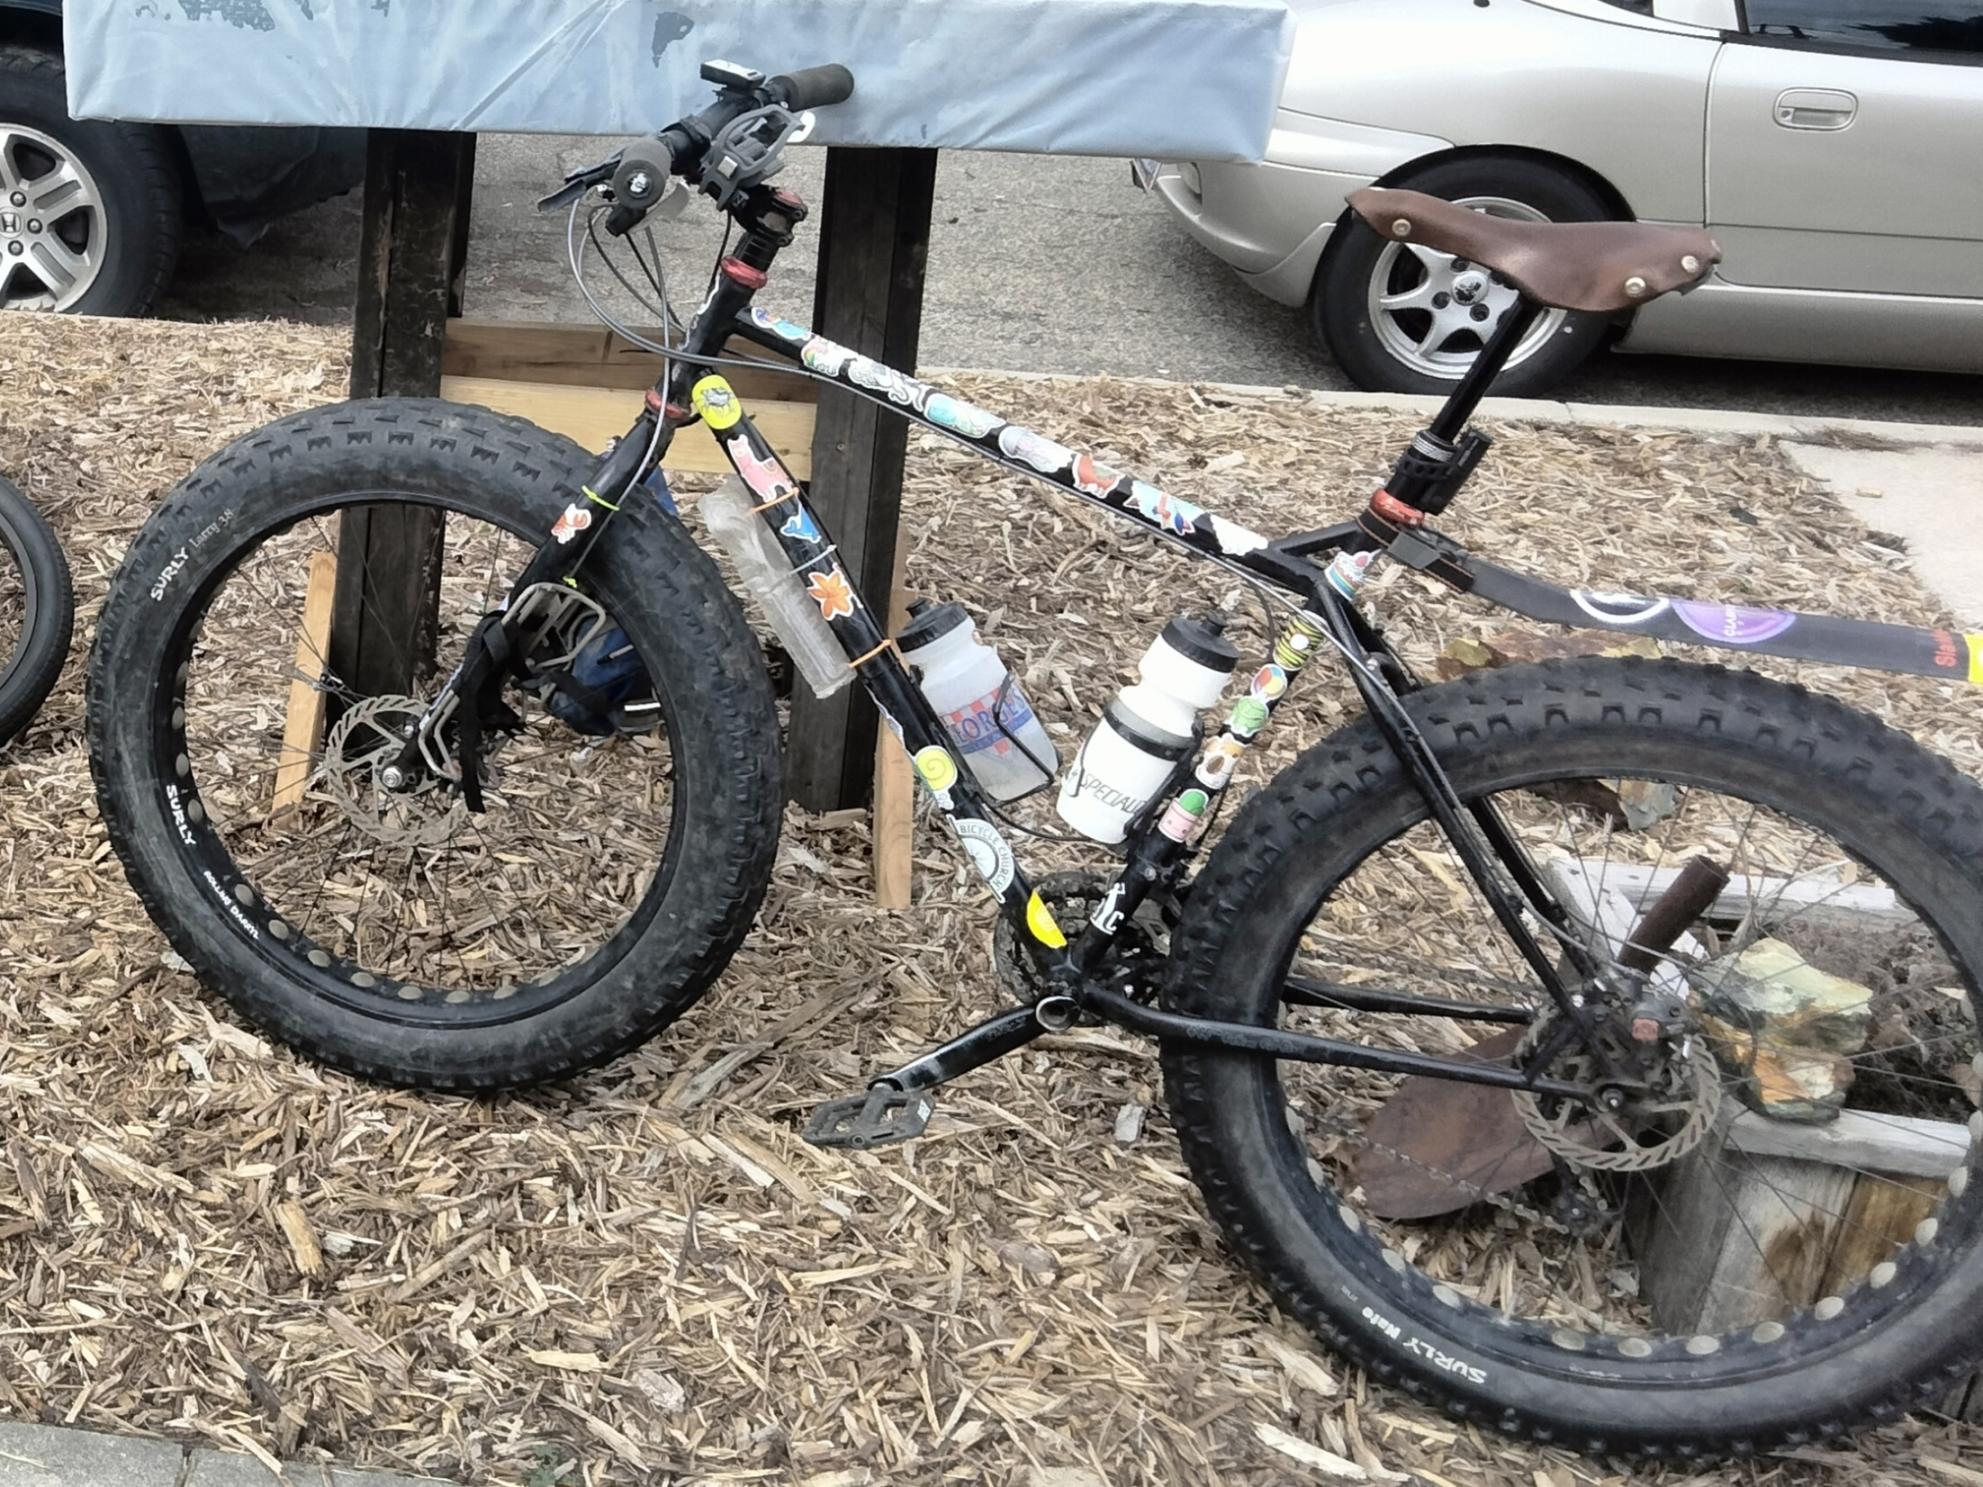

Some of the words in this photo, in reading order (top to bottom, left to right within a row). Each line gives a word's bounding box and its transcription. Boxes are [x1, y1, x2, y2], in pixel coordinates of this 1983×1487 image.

[150, 546, 189, 602] SURLY
[166, 784, 197, 845] SURLY
[959, 824, 999, 845] BICYCLE
[992, 845, 1009, 892] CHURCH
[229, 904, 260, 941] DARRYL
[1402, 1336, 1488, 1385] SURLY
